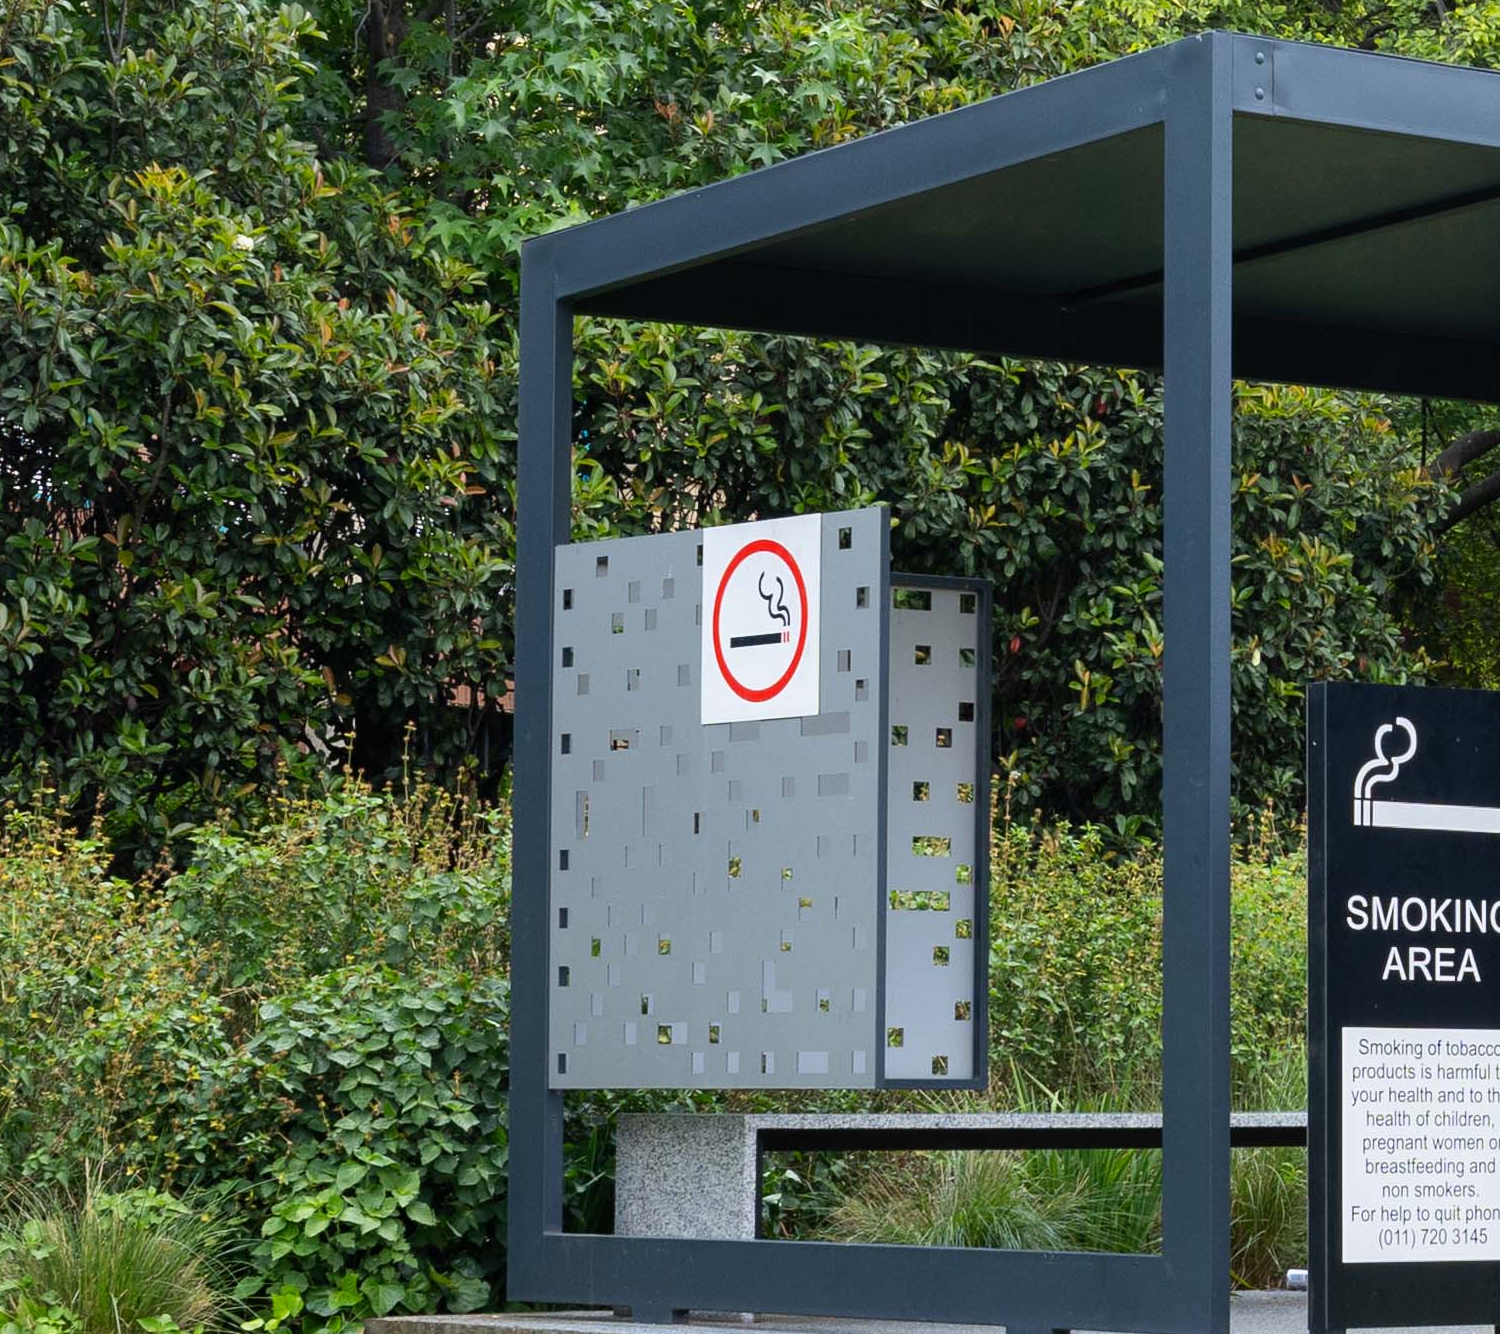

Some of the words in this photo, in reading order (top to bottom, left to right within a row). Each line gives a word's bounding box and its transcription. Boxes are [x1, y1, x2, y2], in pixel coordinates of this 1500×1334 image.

[1383, 947, 1480, 981] AREA
[1359, 1039, 1422, 1059] Smoking
[1428, 1040, 1441, 1055] of
[1353, 1063, 1415, 1082] products
[1421, 1064, 1432, 1079] is
[1438, 1064, 1490, 1079] harmful
[1351, 1091, 1384, 1106] your
[1389, 1087, 1432, 1102] health
[1438, 1088, 1464, 1102] and
[1470, 1089, 1482, 1103] to
[1367, 1111, 1410, 1126] health
[1416, 1110, 1430, 1126] of
[1435, 1111, 1494, 1127] children,
[1363, 1136, 1427, 1154] pregnant
[1432, 1138, 1483, 1150] women
[1366, 1158, 1464, 1178] breastfeeding
[1470, 1158, 1495, 1173] and
[1383, 1186, 1408, 1197] non
[1415, 1182, 1479, 1197] smokers.
[1352, 1206, 1376, 1222] For
[1381, 1206, 1411, 1225] help
[1417, 1206, 1429, 1221] to
[1435, 1207, 1460, 1224] quit
[1379, 1229, 1415, 1249] (011)
[1421, 1229, 1447, 1244] 720
[1453, 1228, 1487, 1244] 3145
